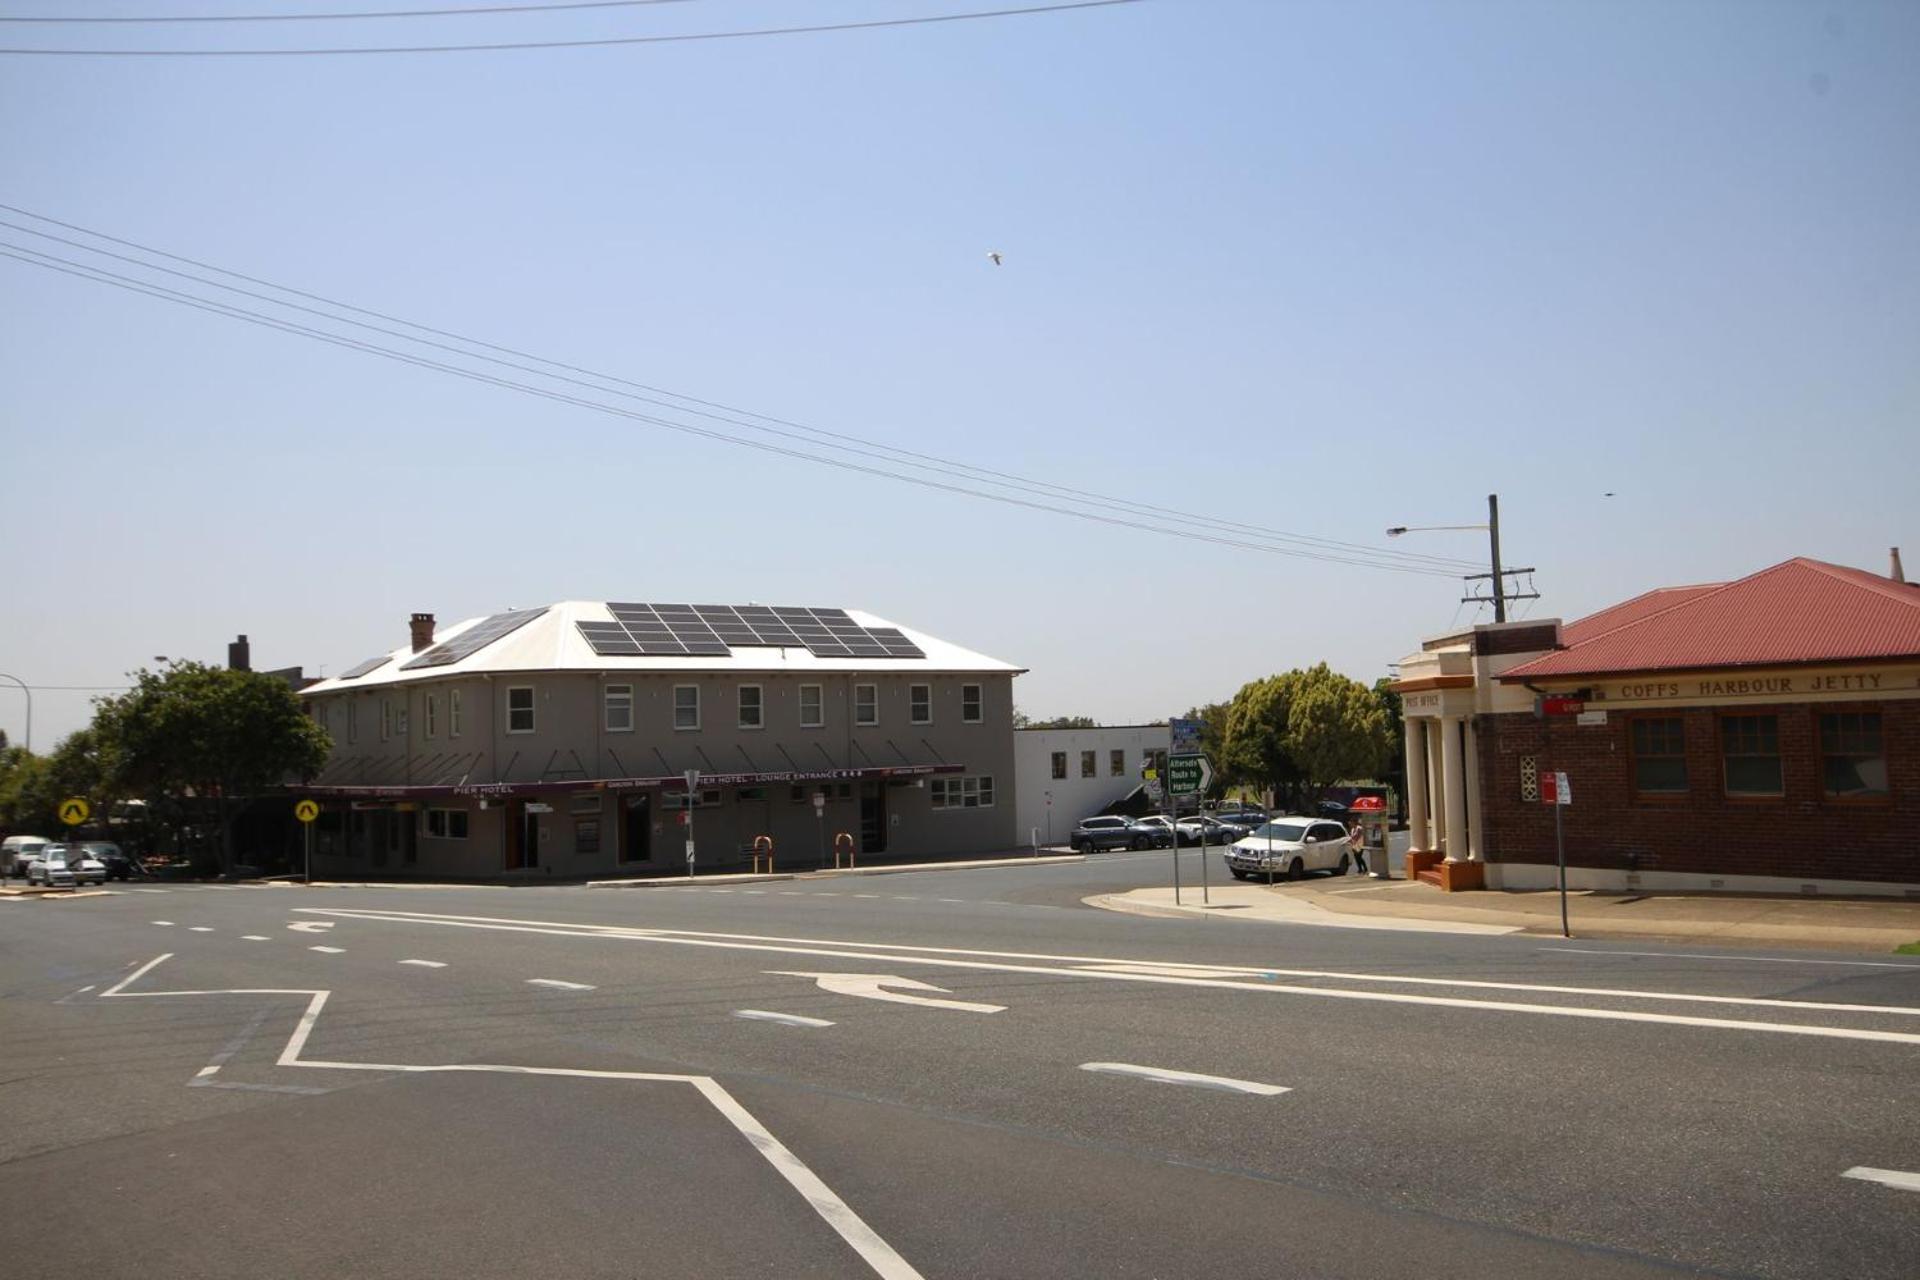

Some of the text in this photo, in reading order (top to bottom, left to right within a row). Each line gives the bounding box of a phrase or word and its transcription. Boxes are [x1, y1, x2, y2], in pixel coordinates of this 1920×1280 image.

[1621, 673, 1882, 698] COFFS HARBOUR JETTY
[718, 776, 746, 784] HOTEL
[755, 774, 792, 783] LOUNGE
[793, 770, 838, 781] ENTRANCE
[453, 785, 514, 795] PIER HOTEL
